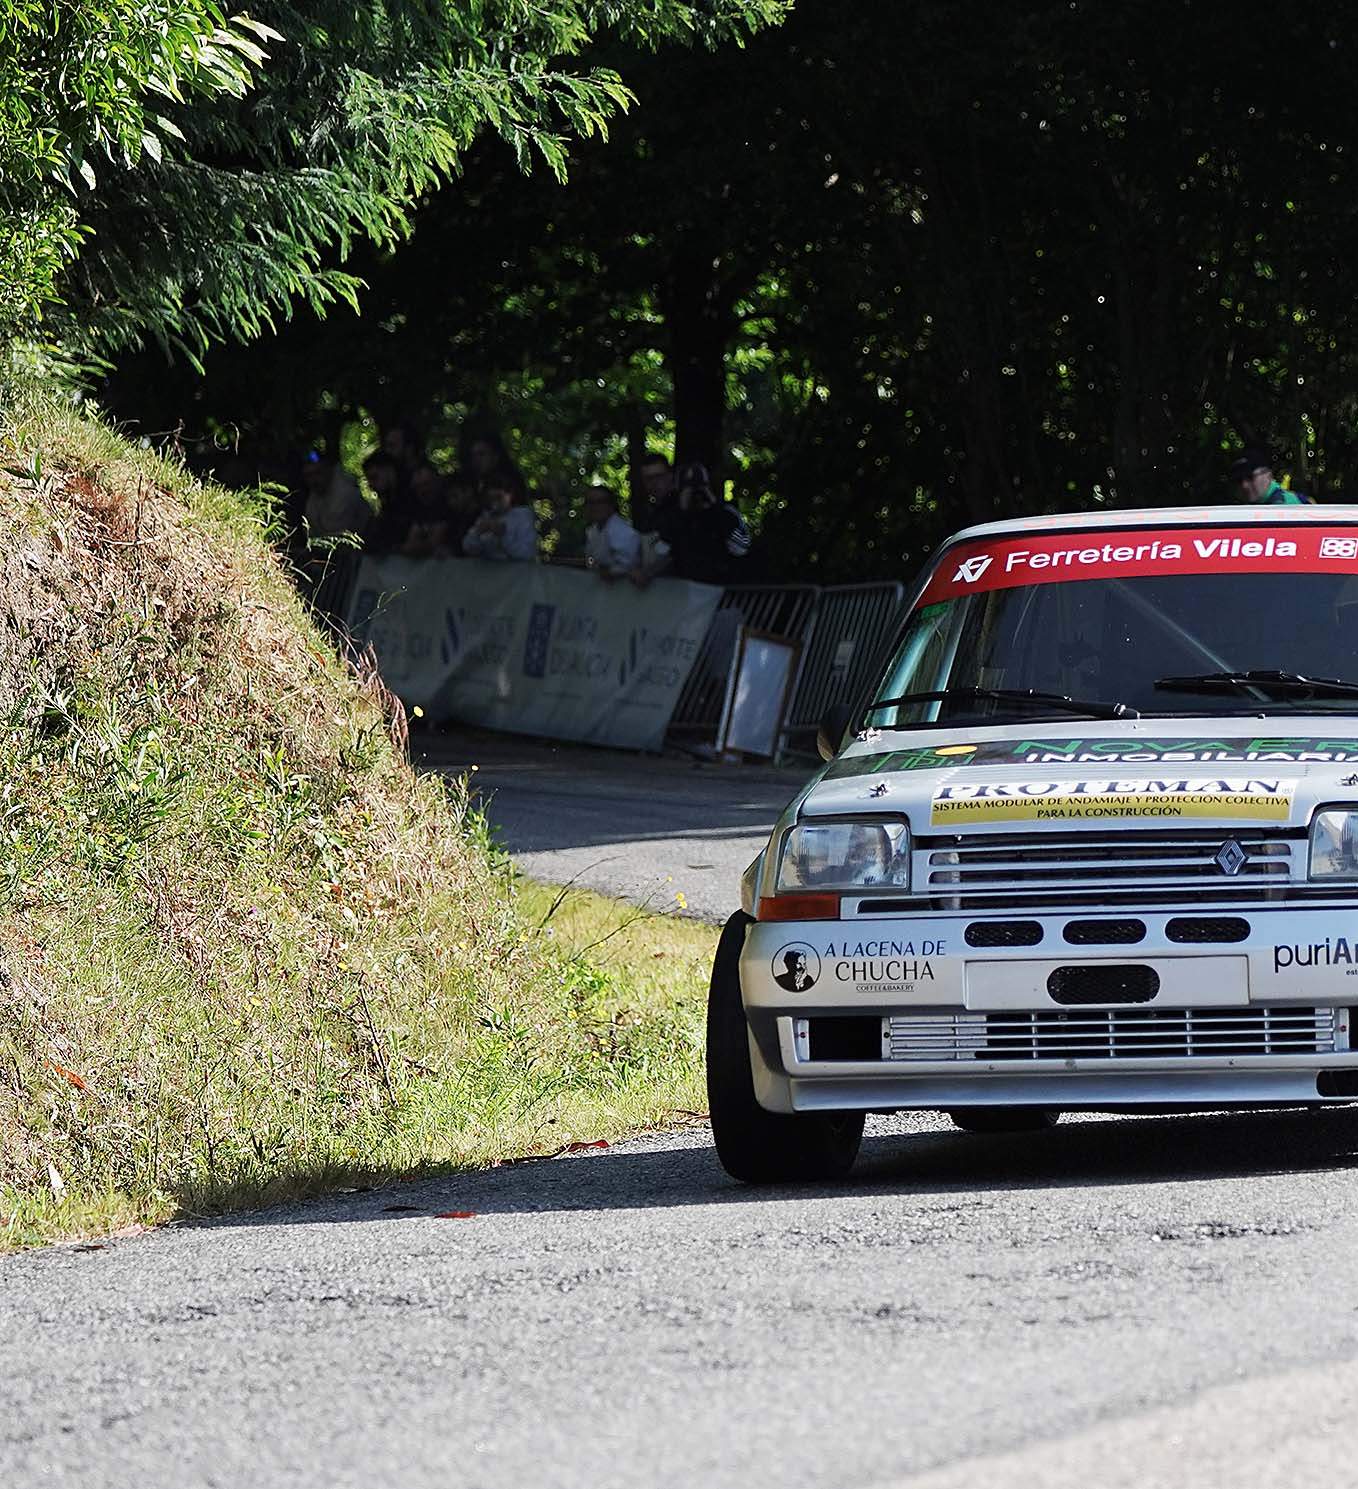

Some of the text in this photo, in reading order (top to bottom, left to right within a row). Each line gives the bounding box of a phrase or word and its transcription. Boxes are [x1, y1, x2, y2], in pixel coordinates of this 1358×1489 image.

[1005, 540, 1182, 572] Ferretería
[1193, 538, 1297, 558] Vilela
[934, 779, 1281, 800] PROTEMAN
[932, 794, 1289, 812] SISTEMA MODULAR DE ANDAMIAJE Y PROTECCIÓN COLECTIVA
[1037, 805, 1182, 819] PARA LA CONSTRUCCIÓN
[824, 940, 947, 958] A LACENA DE
[835, 960, 935, 982] CHUCHA
